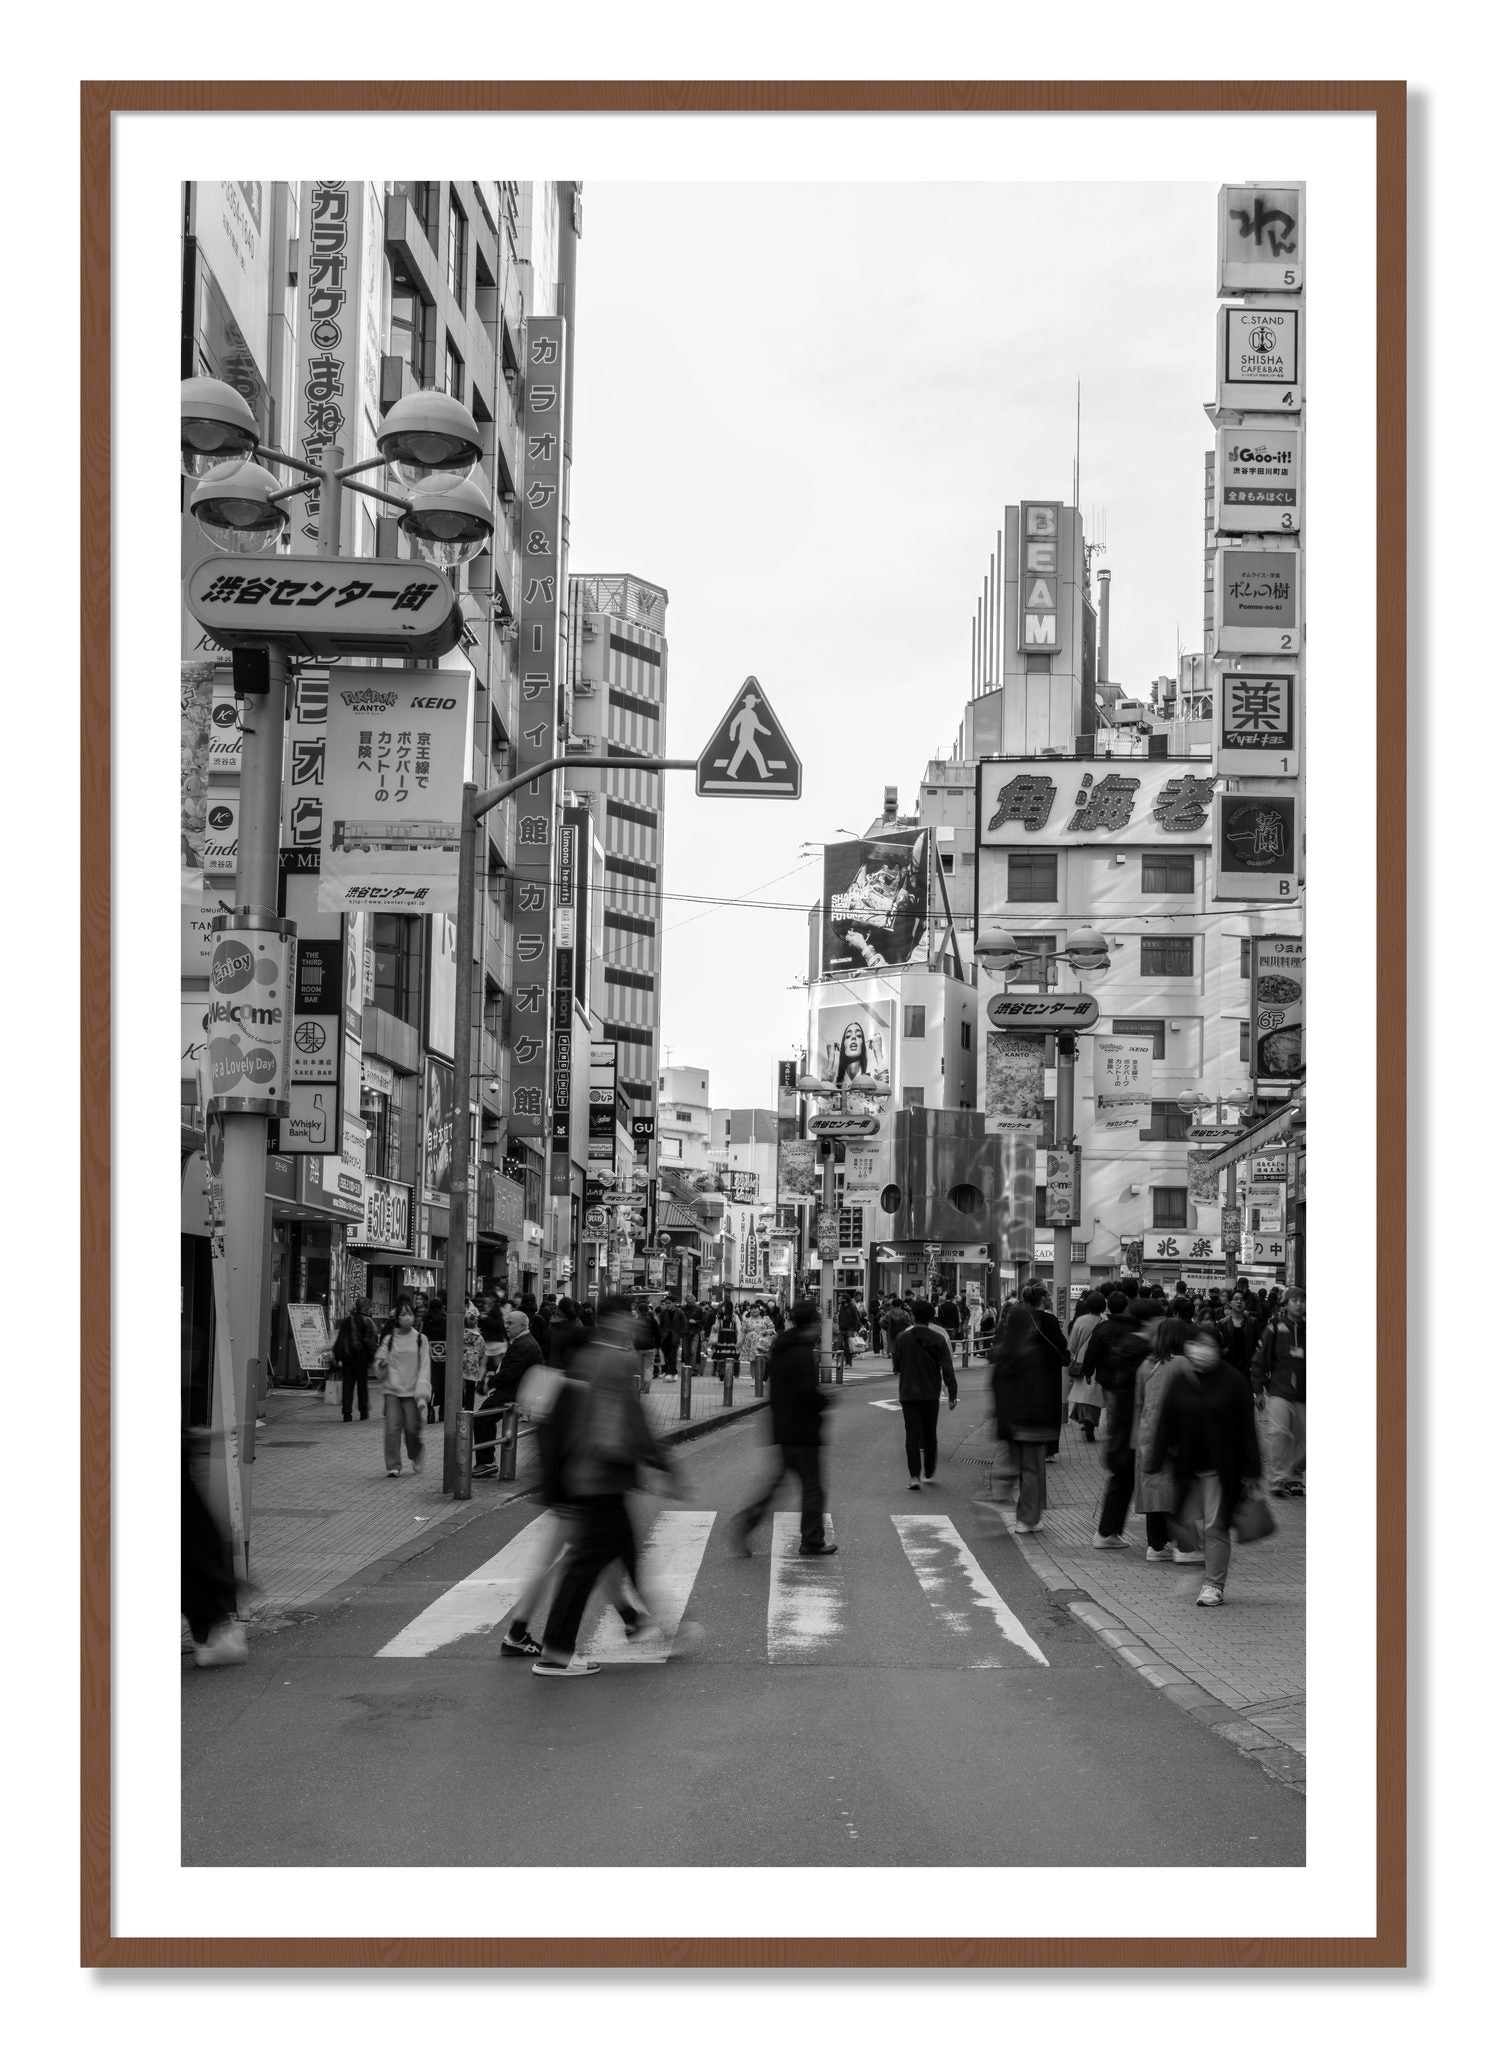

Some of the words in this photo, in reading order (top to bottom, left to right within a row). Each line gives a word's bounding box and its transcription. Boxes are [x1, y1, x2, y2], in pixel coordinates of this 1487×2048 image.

[309, 190, 349, 322] カラオケ
[1284, 270, 1295, 285] 5
[1241, 316, 1284, 325] C.STAND
[1241, 355, 1283, 365] SHISHA
[1241, 365, 1284, 373] CAFE&BAR
[1240, 448, 1291, 463] Goo-it!
[1228, 491, 1293, 503] 全身もみほぐし
[1282, 513, 1293, 529] 3
[1025, 506, 1057, 644] BEAM
[200, 575, 439, 611] 渋谷センター街
[1281, 635, 1292, 650] 2
[410, 697, 457, 710] KEIO
[1232, 681, 1280, 729] 薬
[357, 731, 373, 772] 冒険へ
[415, 732, 431, 789] 京王線で
[213, 757, 236, 766] 渋谷店
[375, 731, 391, 802] カントーの
[1280, 758, 1288, 772] 1
[988, 773, 1214, 831] 角海老
[1227, 811, 1284, 857] 一蘭
[563, 831, 571, 864] kimono
[209, 860, 233, 868] 渋谷店
[345, 886, 430, 899] 渋谷センター街
[562, 870, 570, 902] hearts
[1279, 880, 1290, 895] B
[213, 953, 250, 986] Enjoy
[513, 883, 546, 1116] カラオケ館
[560, 978, 568, 1024] union
[994, 1002, 1094, 1015] 渋谷センター街
[208, 1001, 283, 1025] Welcome
[1257, 1010, 1285, 1030] 6F
[225, 1057, 254, 1075] Lovely
[256, 1058, 275, 1071] Day!
[289, 1129, 308, 1137] Bank
[291, 1120, 321, 1130] Whisky
[634, 1123, 653, 1133] GU
[747, 1236, 755, 1275] BEER
[1157, 1237, 1213, 1257] 兆楽
